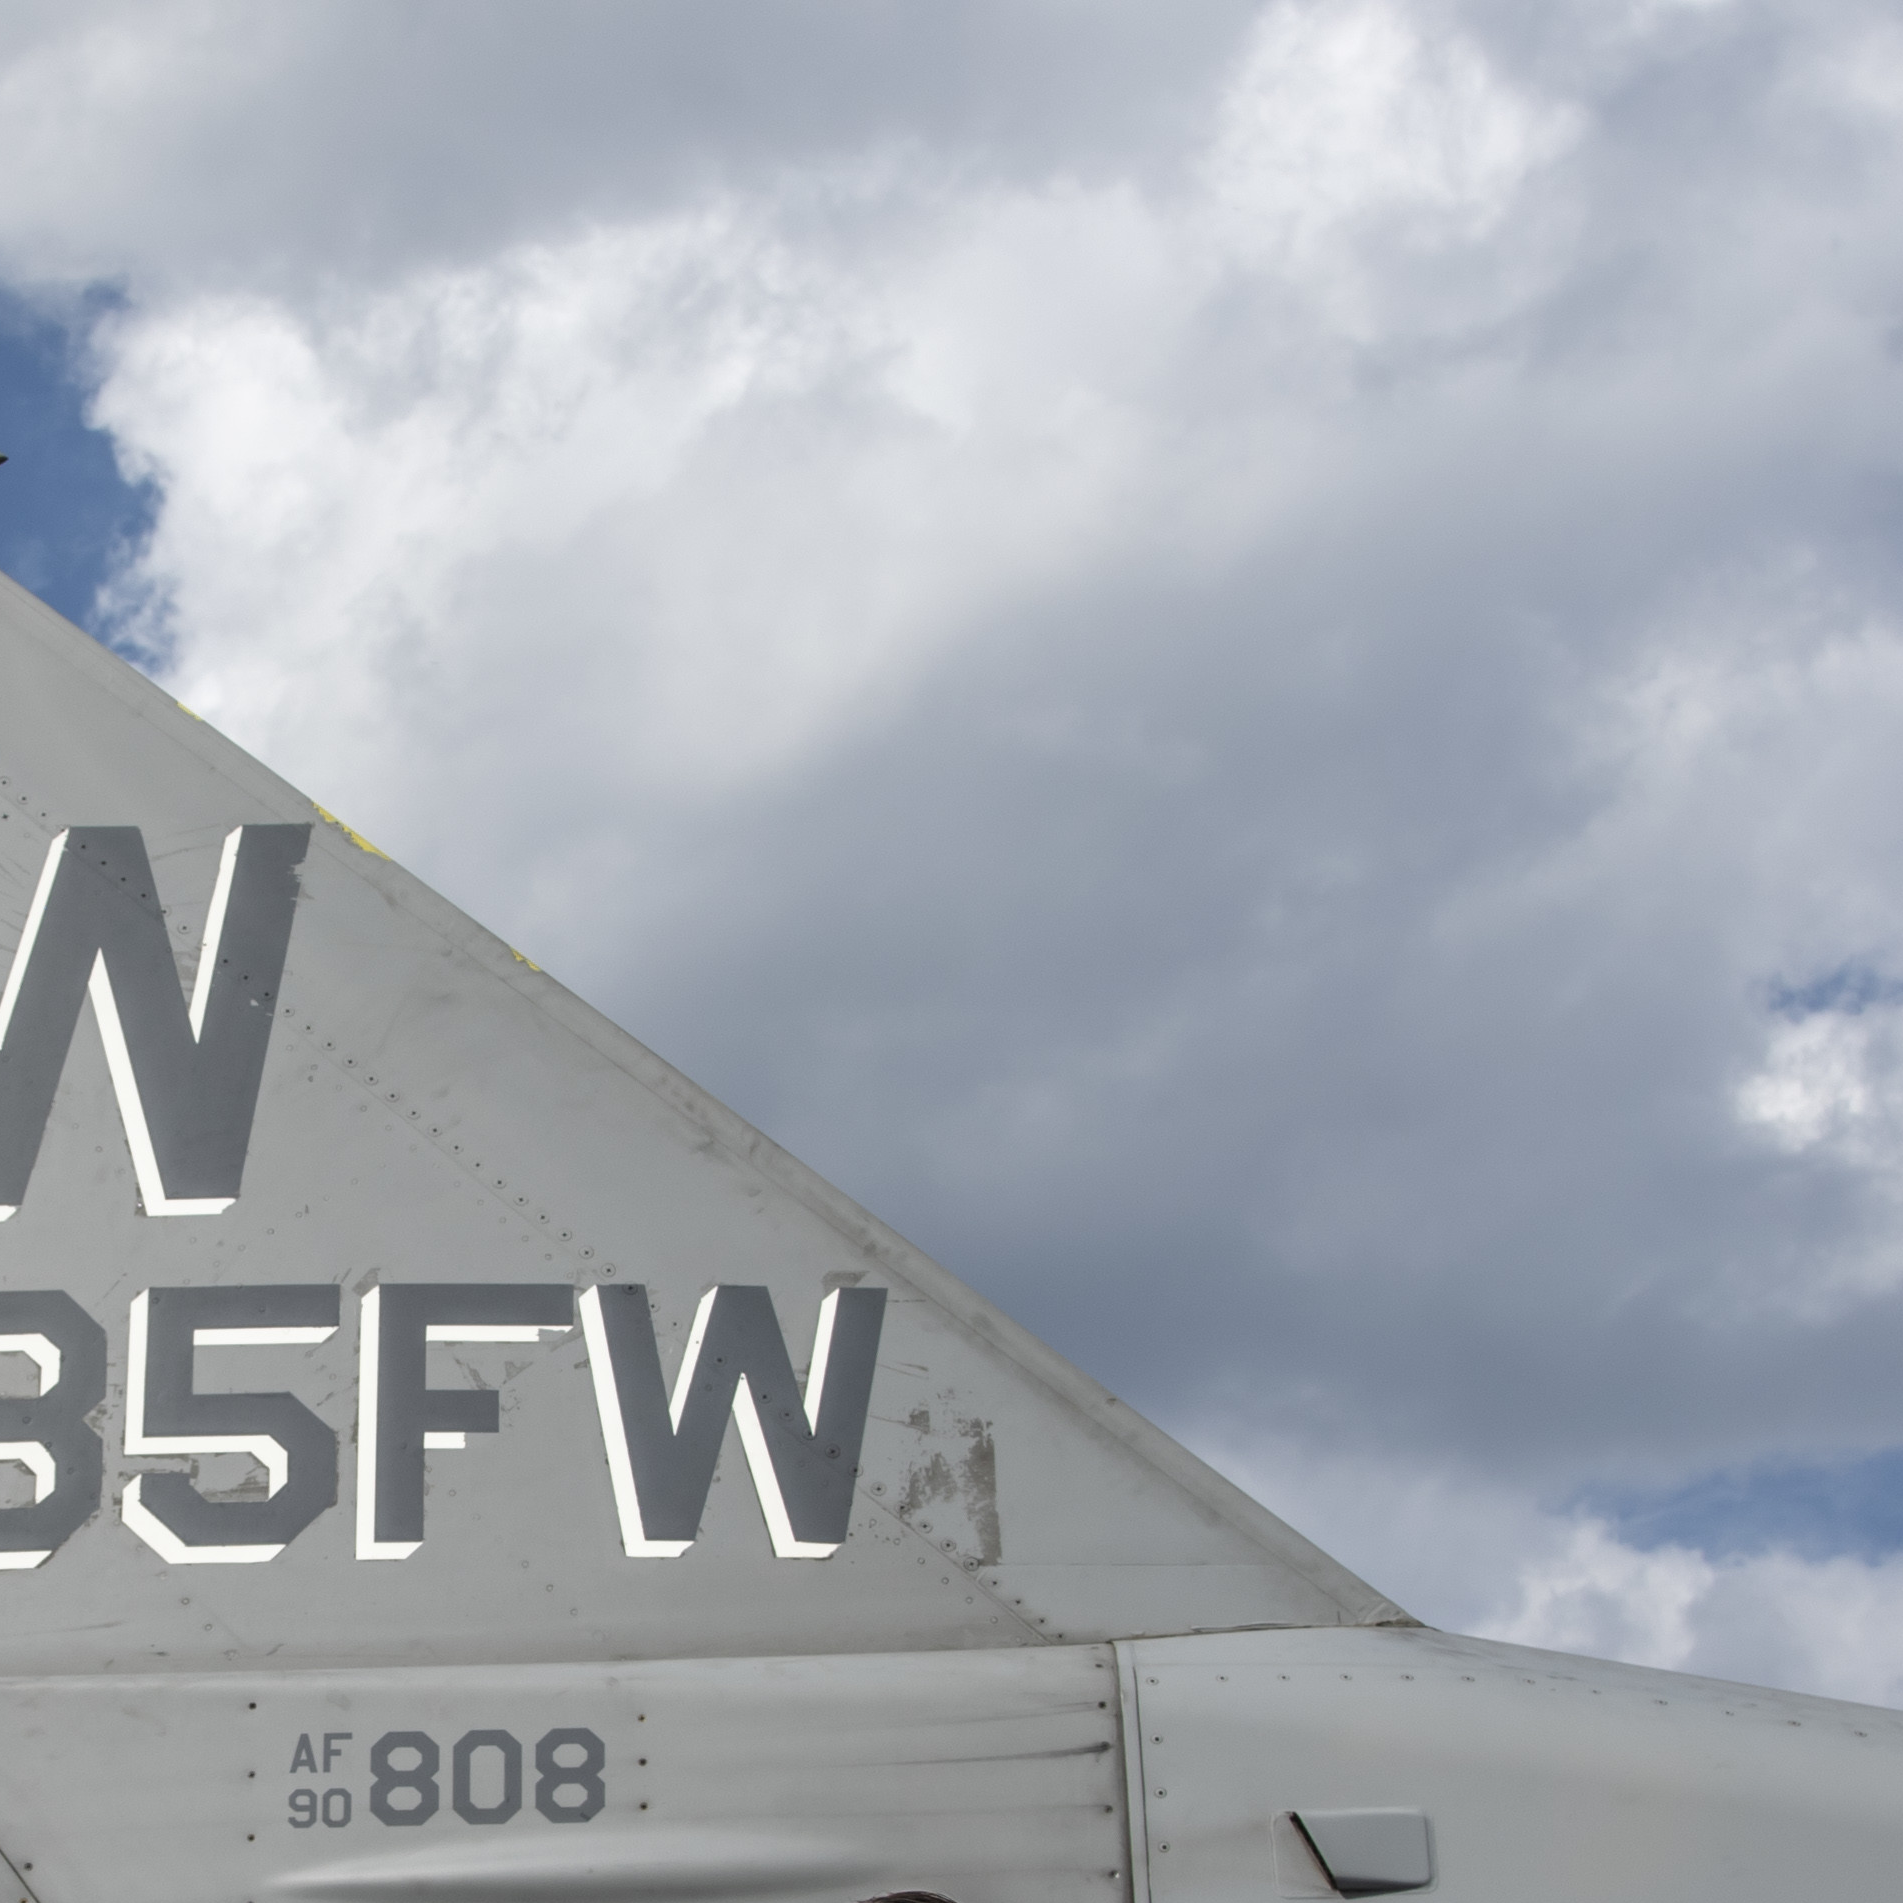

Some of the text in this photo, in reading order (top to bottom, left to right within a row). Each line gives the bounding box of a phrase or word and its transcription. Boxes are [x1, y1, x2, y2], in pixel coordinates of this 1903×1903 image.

[289, 1732, 353, 1774] AF
[369, 1727, 606, 1827] 808
[287, 1787, 352, 1829] 90
